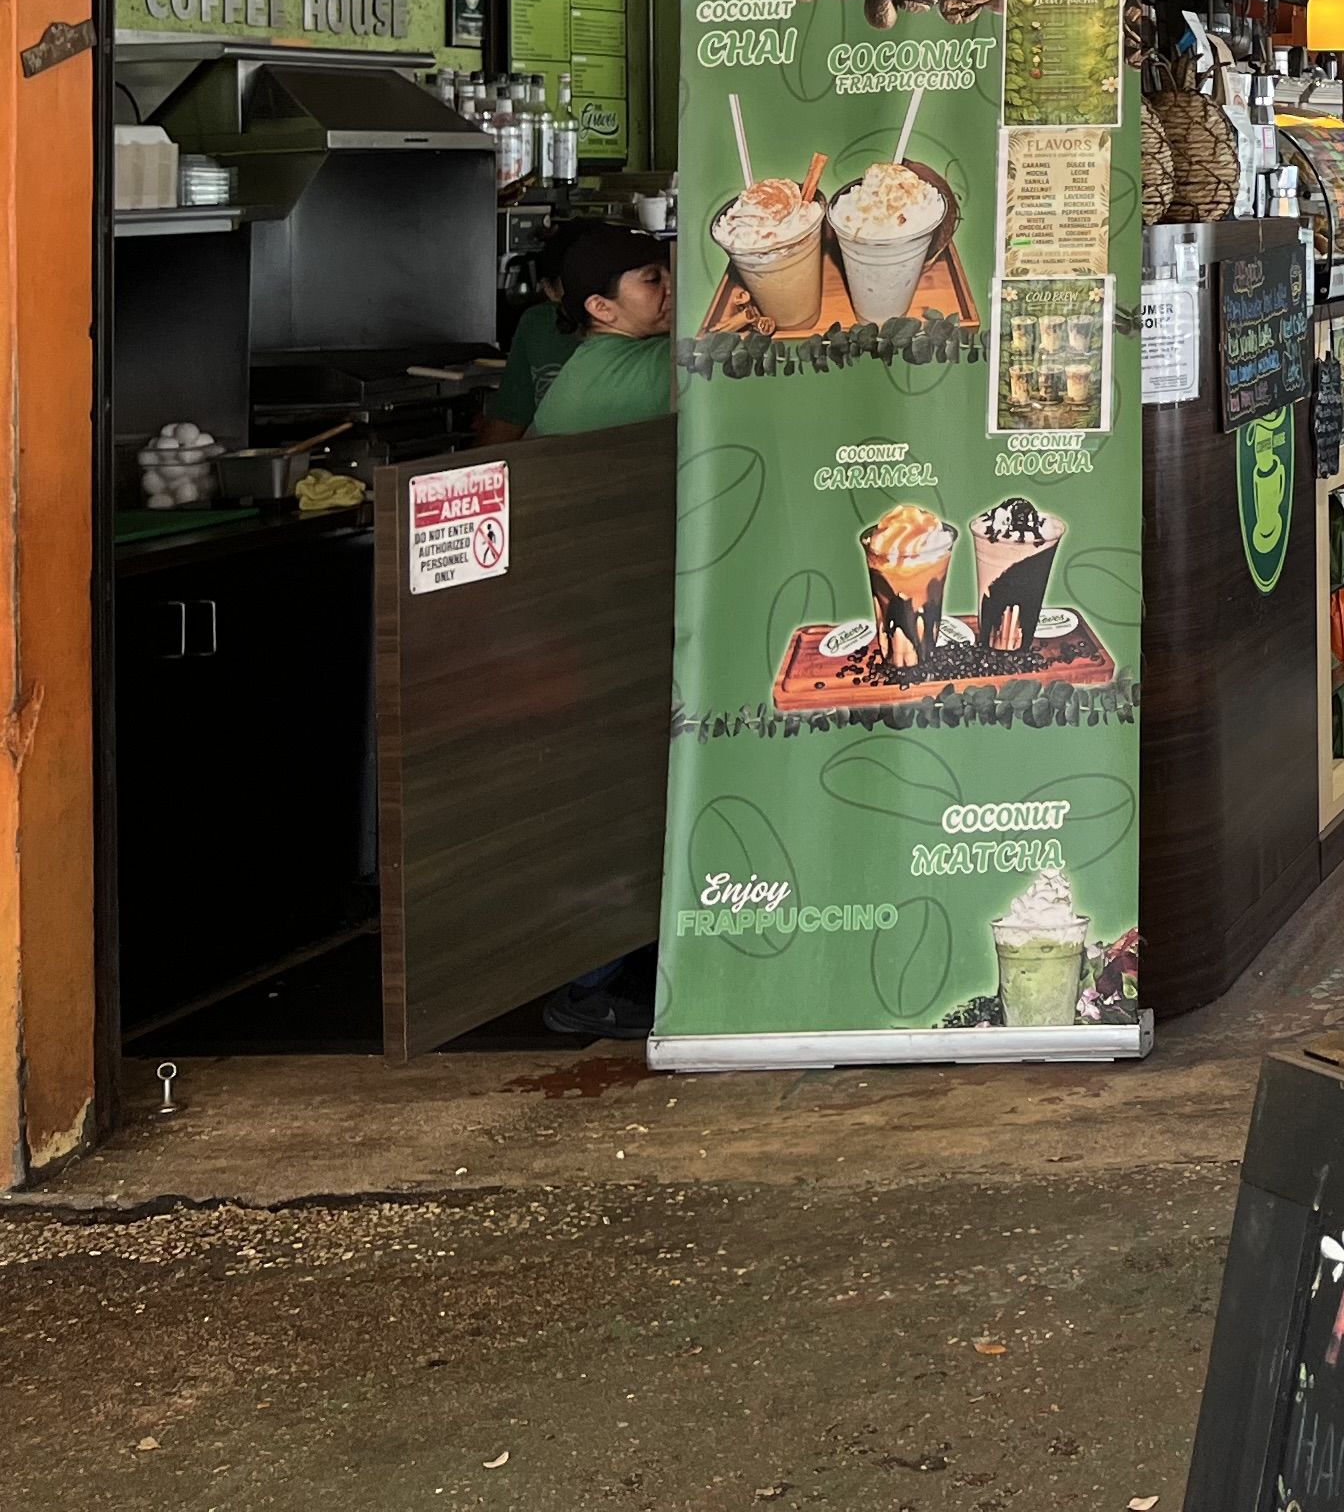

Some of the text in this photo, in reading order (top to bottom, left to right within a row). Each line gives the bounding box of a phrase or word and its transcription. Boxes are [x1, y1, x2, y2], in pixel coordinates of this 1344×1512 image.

[698, 28, 797, 67] CHAI
[828, 38, 996, 75] COCONUT
[836, 70, 975, 94] FRAPPUCCINO
[1027, 139, 1093, 151] FLAVORS
[1026, 290, 1079, 303] COLD BREW
[835, 442, 909, 464] COCONUT
[1008, 432, 1085, 451] COCONUT
[813, 462, 938, 490] CARAMEL
[995, 451, 1094, 476] MOCHA
[415, 472, 503, 504] RESTRICTED
[440, 495, 480, 520] AREA
[415, 522, 475, 545] DO NOT ENTER
[419, 537, 471, 558] AUTHORIZED
[421, 552, 469, 572] PERSONNEL
[435, 569, 456, 584] ONLY
[941, 799, 1071, 834] COCONUT
[910, 839, 1065, 877] MATCHA
[700, 872, 792, 914] Enjoy
[676, 903, 899, 937] FRAPPUCCINO
